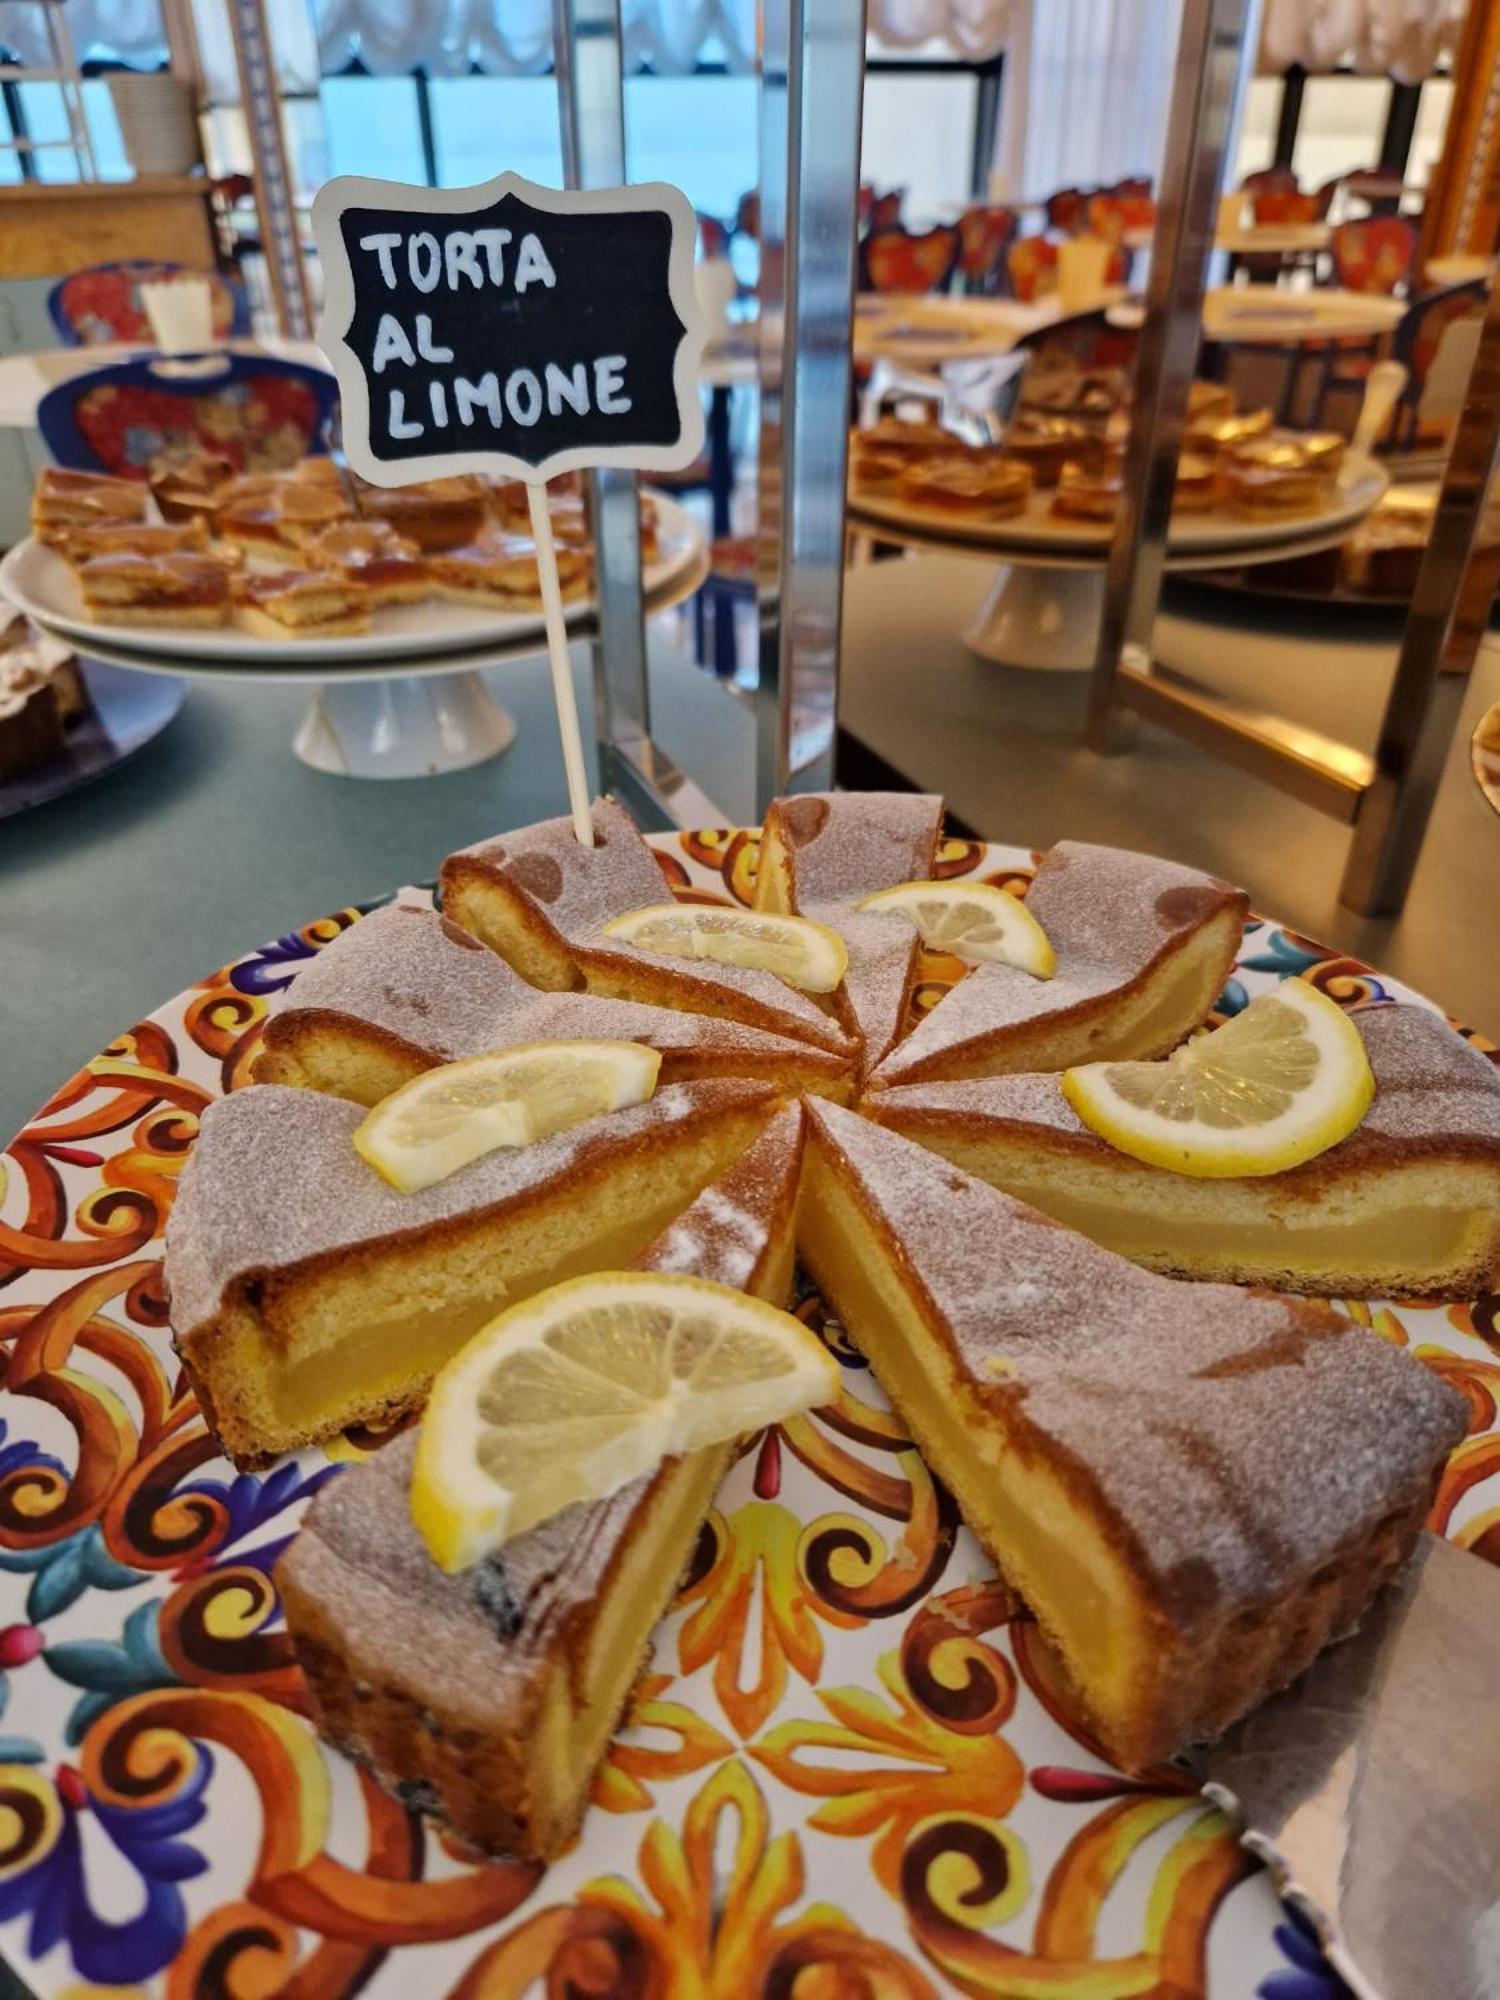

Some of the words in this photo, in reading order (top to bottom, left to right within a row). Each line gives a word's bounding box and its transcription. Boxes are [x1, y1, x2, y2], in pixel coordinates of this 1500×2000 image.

[359, 229, 556, 293] TORTA
[373, 314, 454, 373] AL
[388, 355, 632, 439] LIMONE
